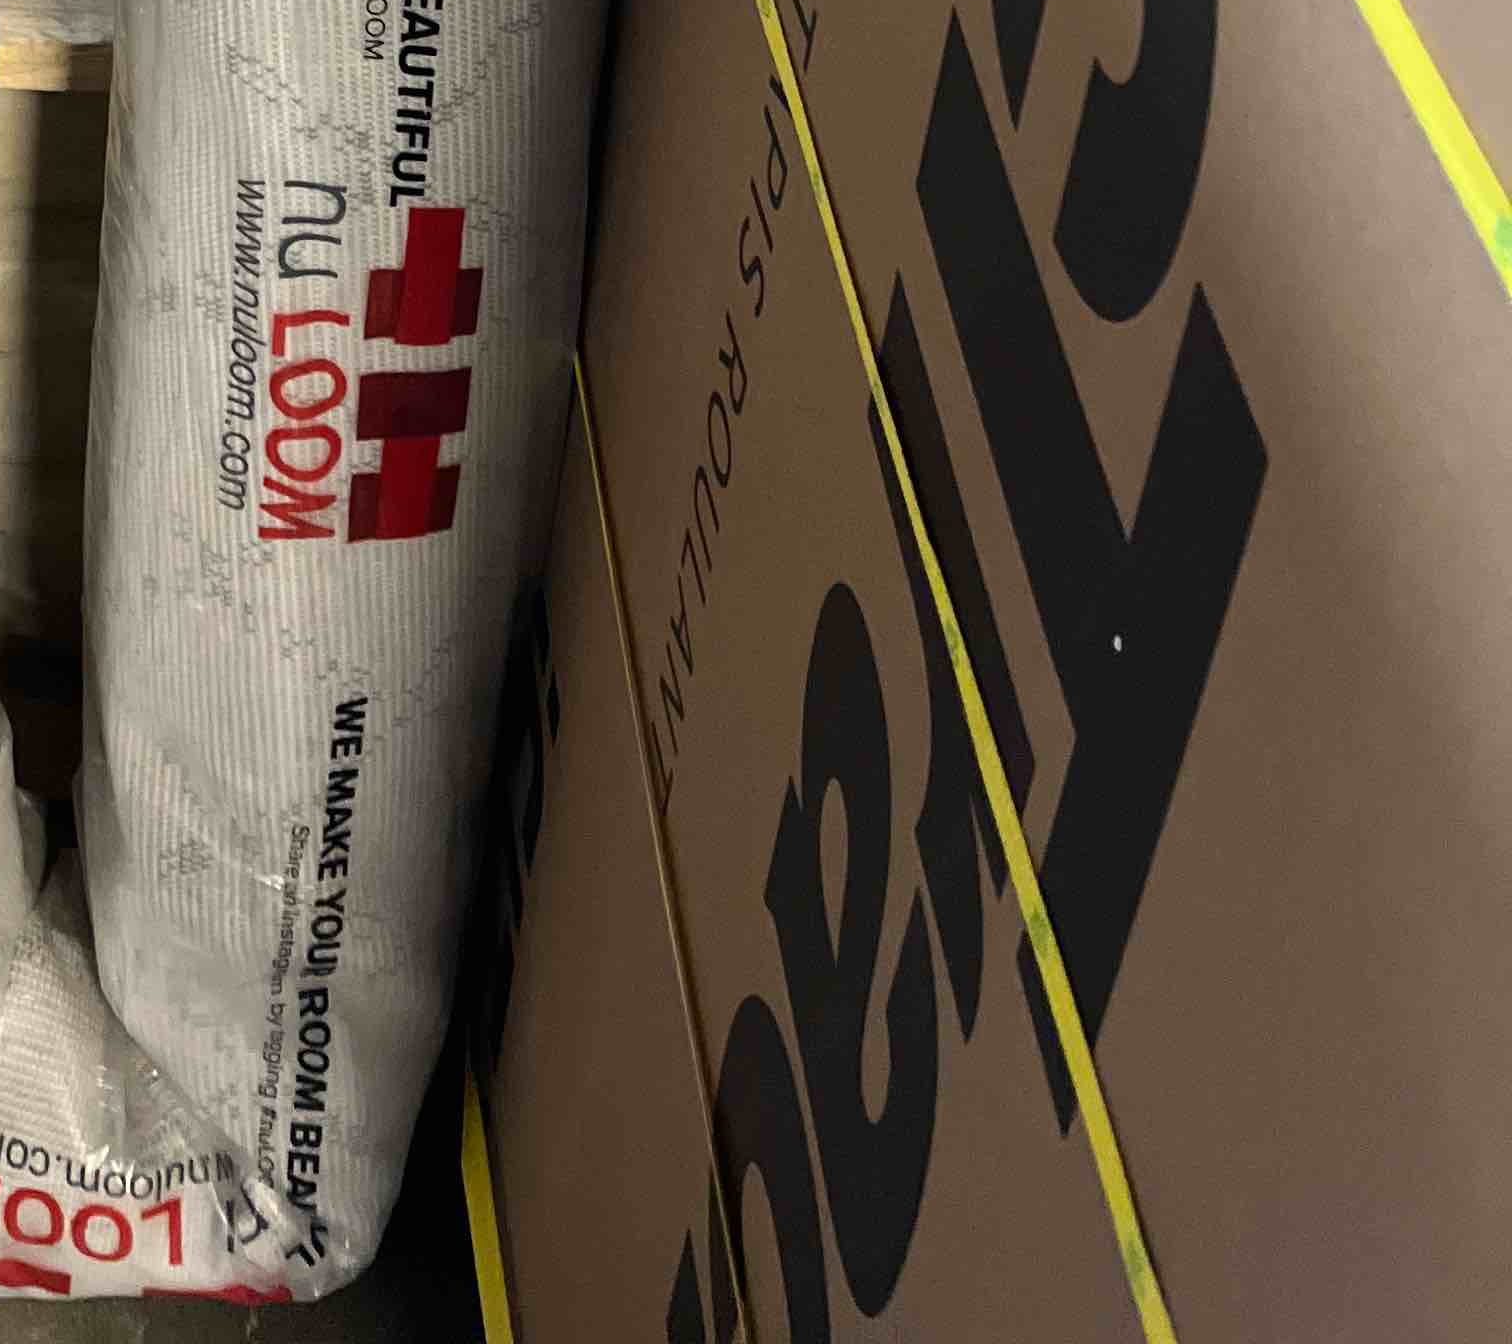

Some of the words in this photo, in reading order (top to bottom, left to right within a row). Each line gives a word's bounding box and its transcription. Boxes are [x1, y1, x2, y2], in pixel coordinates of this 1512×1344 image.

[277, 178, 347, 280] nu
[217, 177, 267, 512] www.nuloom.com
[257, 311, 351, 541] LOOM
[329, 697, 369, 758] WE
[285, 823, 310, 879] Share
[316, 768, 360, 881] MAKE
[291, 987, 332, 1111] ROOM
